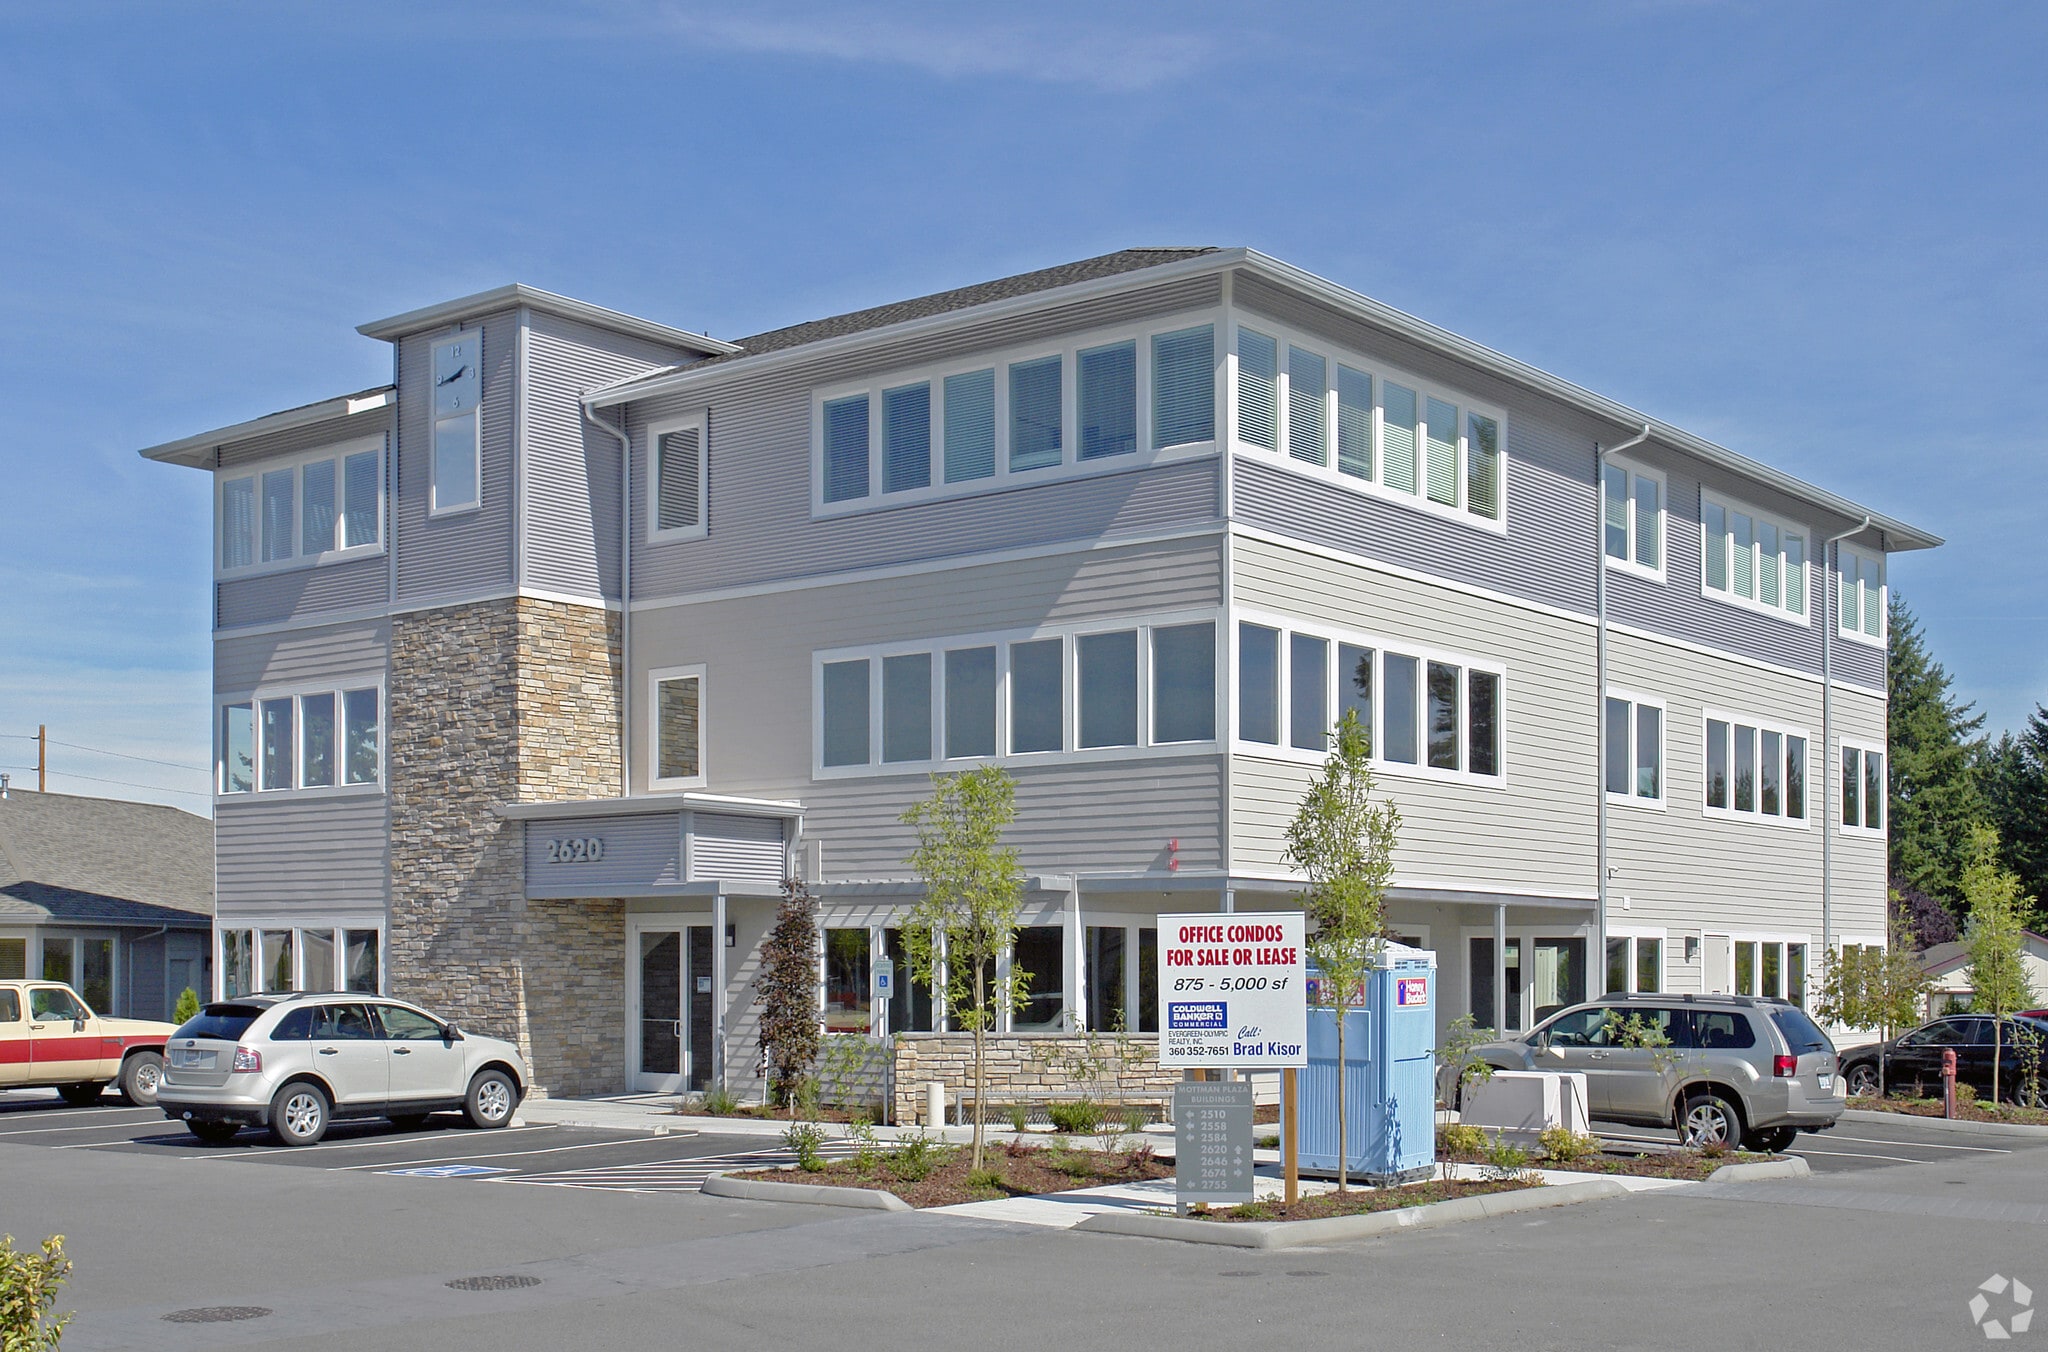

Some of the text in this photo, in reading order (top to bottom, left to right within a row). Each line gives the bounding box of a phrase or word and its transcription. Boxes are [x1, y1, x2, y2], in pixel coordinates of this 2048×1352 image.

[451, 345, 461, 358] 12
[468, 367, 475, 378] 3
[453, 397, 460, 408] 6
[546, 838, 602, 863] 2620
[1179, 925, 1283, 943] OFFICE CONDOS
[1167, 948, 1297, 966] FOR SALE OR LEASE
[1174, 978, 1204, 991] 875
[1219, 977, 1267, 992] 5,000
[1271, 977, 1289, 990] sf
[1172, 1005, 1222, 1013] COLDWELL
[1173, 1012, 1214, 1021] BANKER
[1168, 1030, 1228, 1038] EVERGREEN-OLYMPIC
[1237, 1025, 1262, 1040] Call:
[1169, 1046, 1229, 1056] 360 352-7651
[1233, 1042, 1301, 1056] Brad Kisor
[1200, 1110, 1226, 1119] 2510
[1200, 1121, 1227, 1131] 2558
[1200, 1133, 1227, 1142] 2584
[1200, 1145, 1227, 1154] 2620
[1200, 1156, 1228, 1166] 2646
[1200, 1168, 1226, 1178] 2674
[1200, 1180, 1227, 1189] 2755
